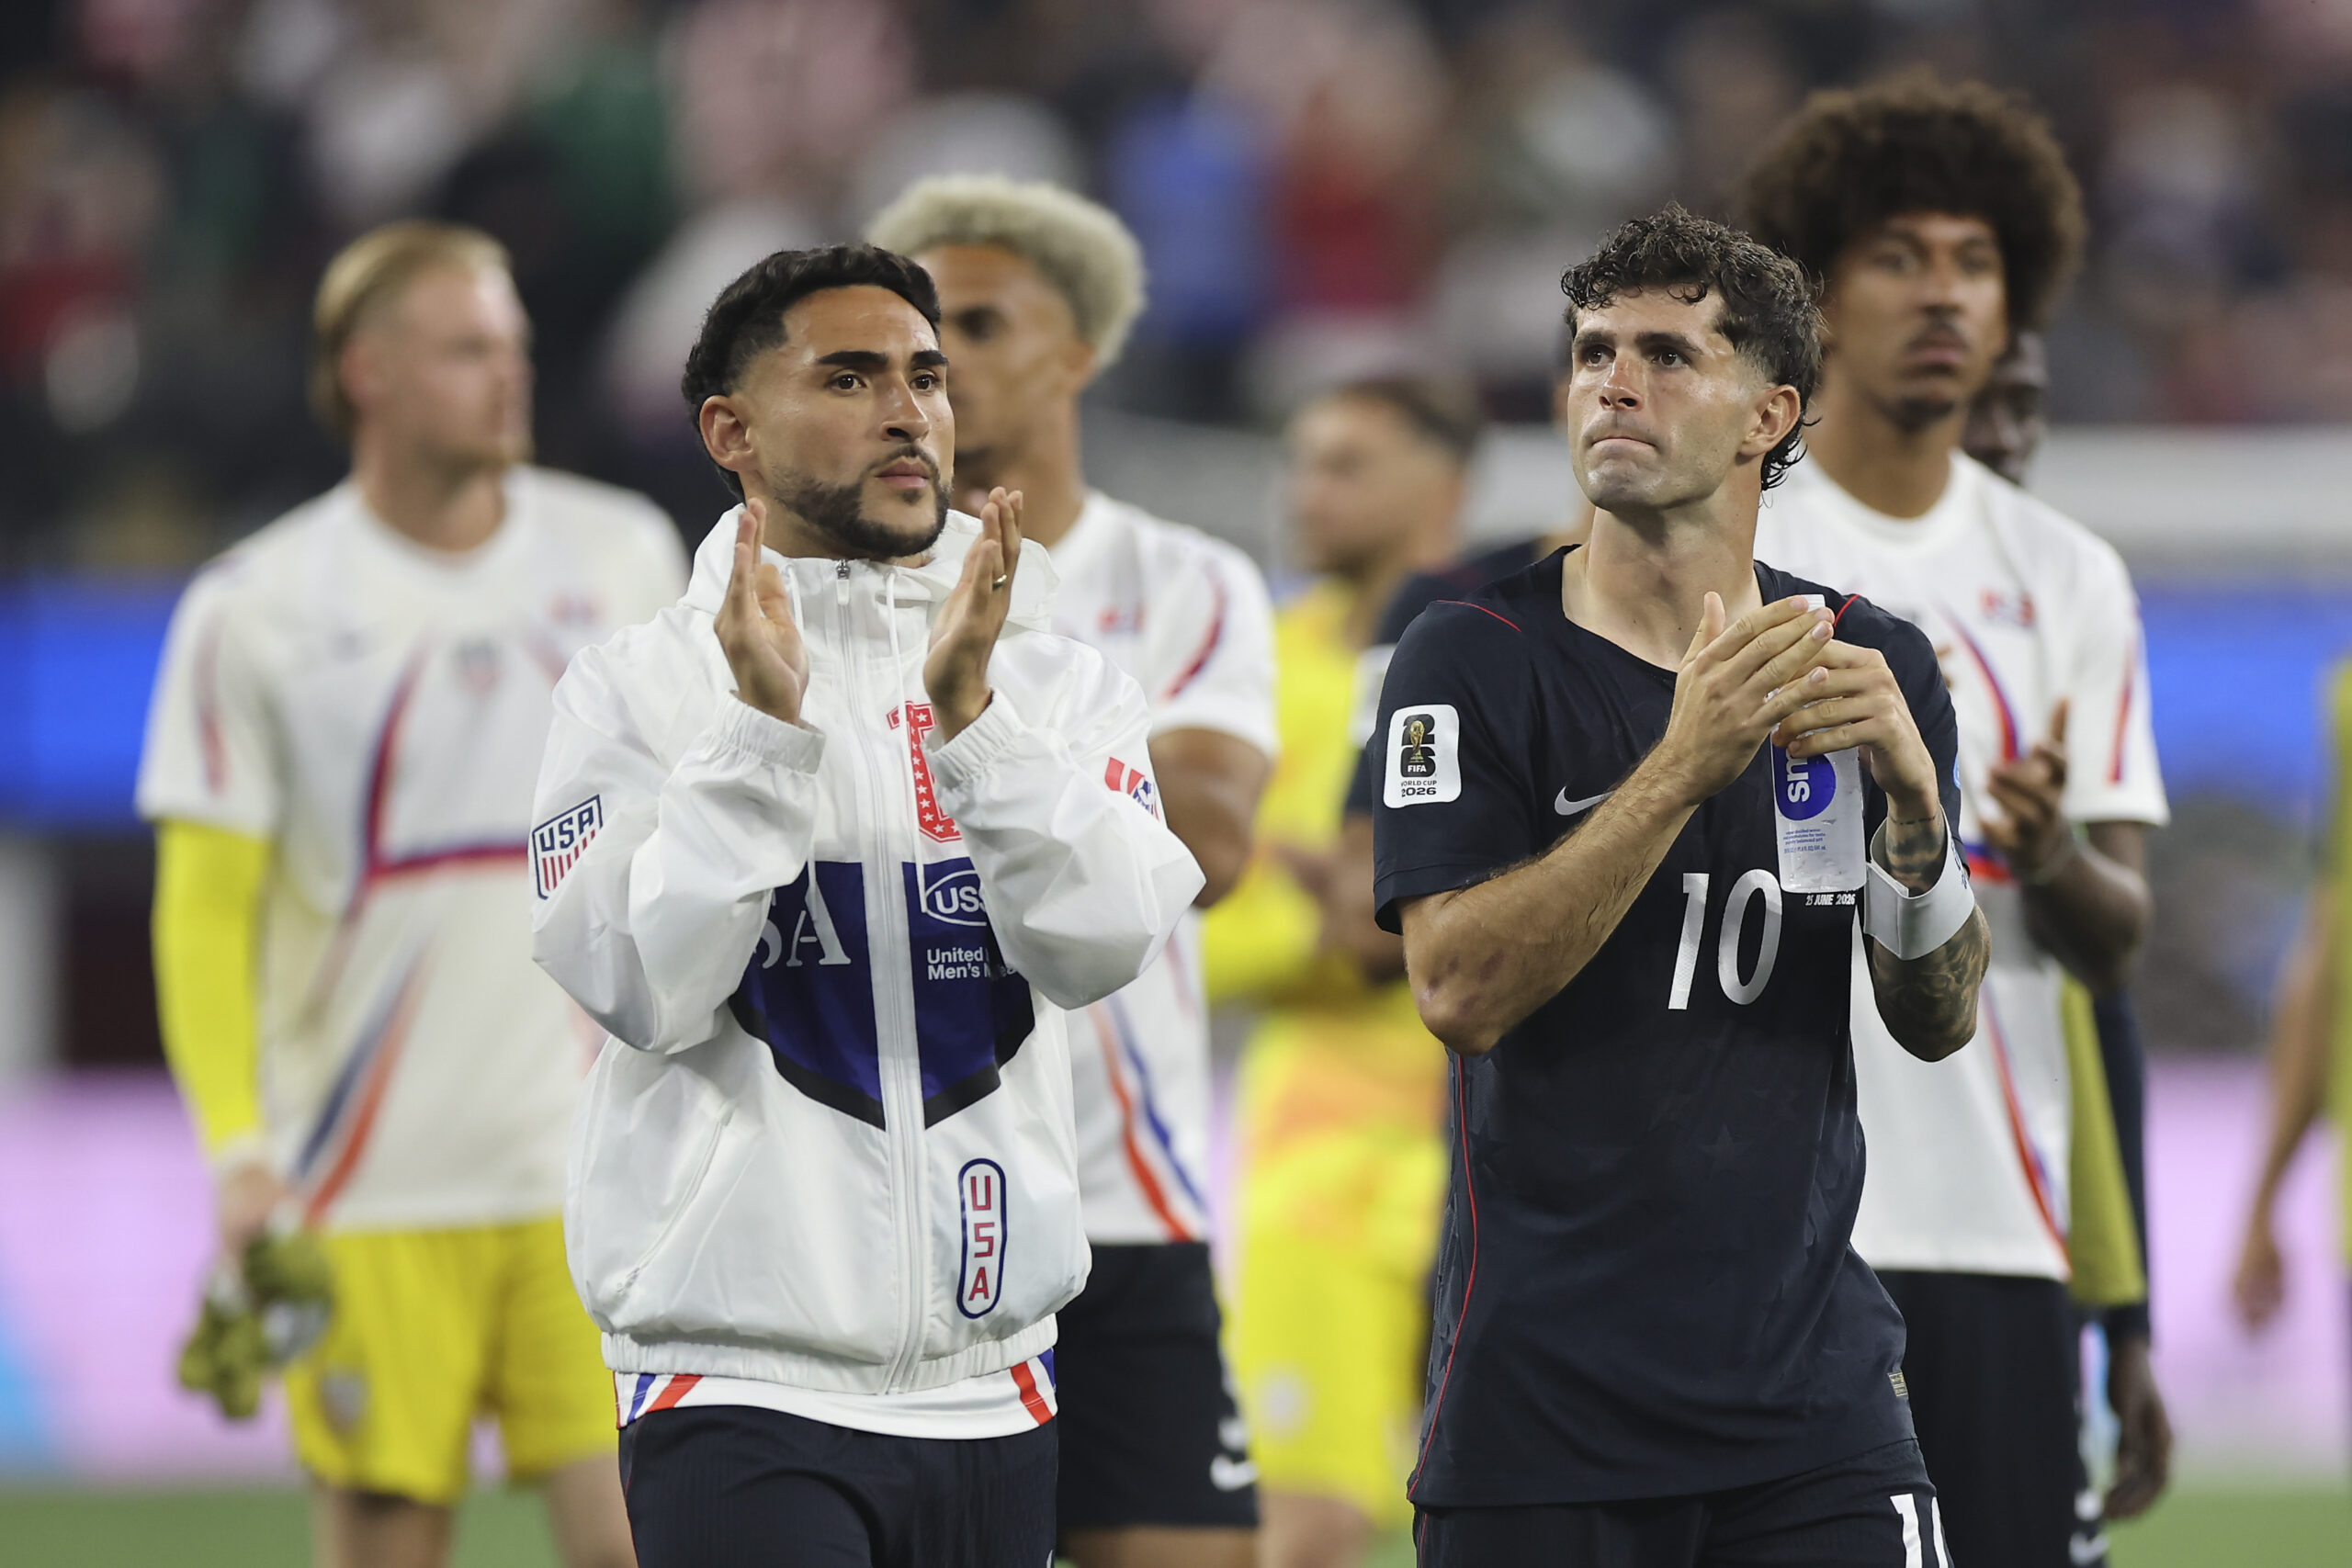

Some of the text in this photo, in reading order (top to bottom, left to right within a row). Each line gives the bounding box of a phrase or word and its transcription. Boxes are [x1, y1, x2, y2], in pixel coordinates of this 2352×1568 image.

[1407, 764, 1427, 773] FIFA
[1401, 787, 1437, 797] 2026
[539, 806, 594, 852] USA
[1814, 894, 1834, 906] JUNE
[1835, 893, 1856, 905] 2026
[1668, 868, 1782, 1010] 10
[926, 947, 983, 964] United
[928, 963, 980, 980] Men's
[967, 1176, 995, 1301] USA
